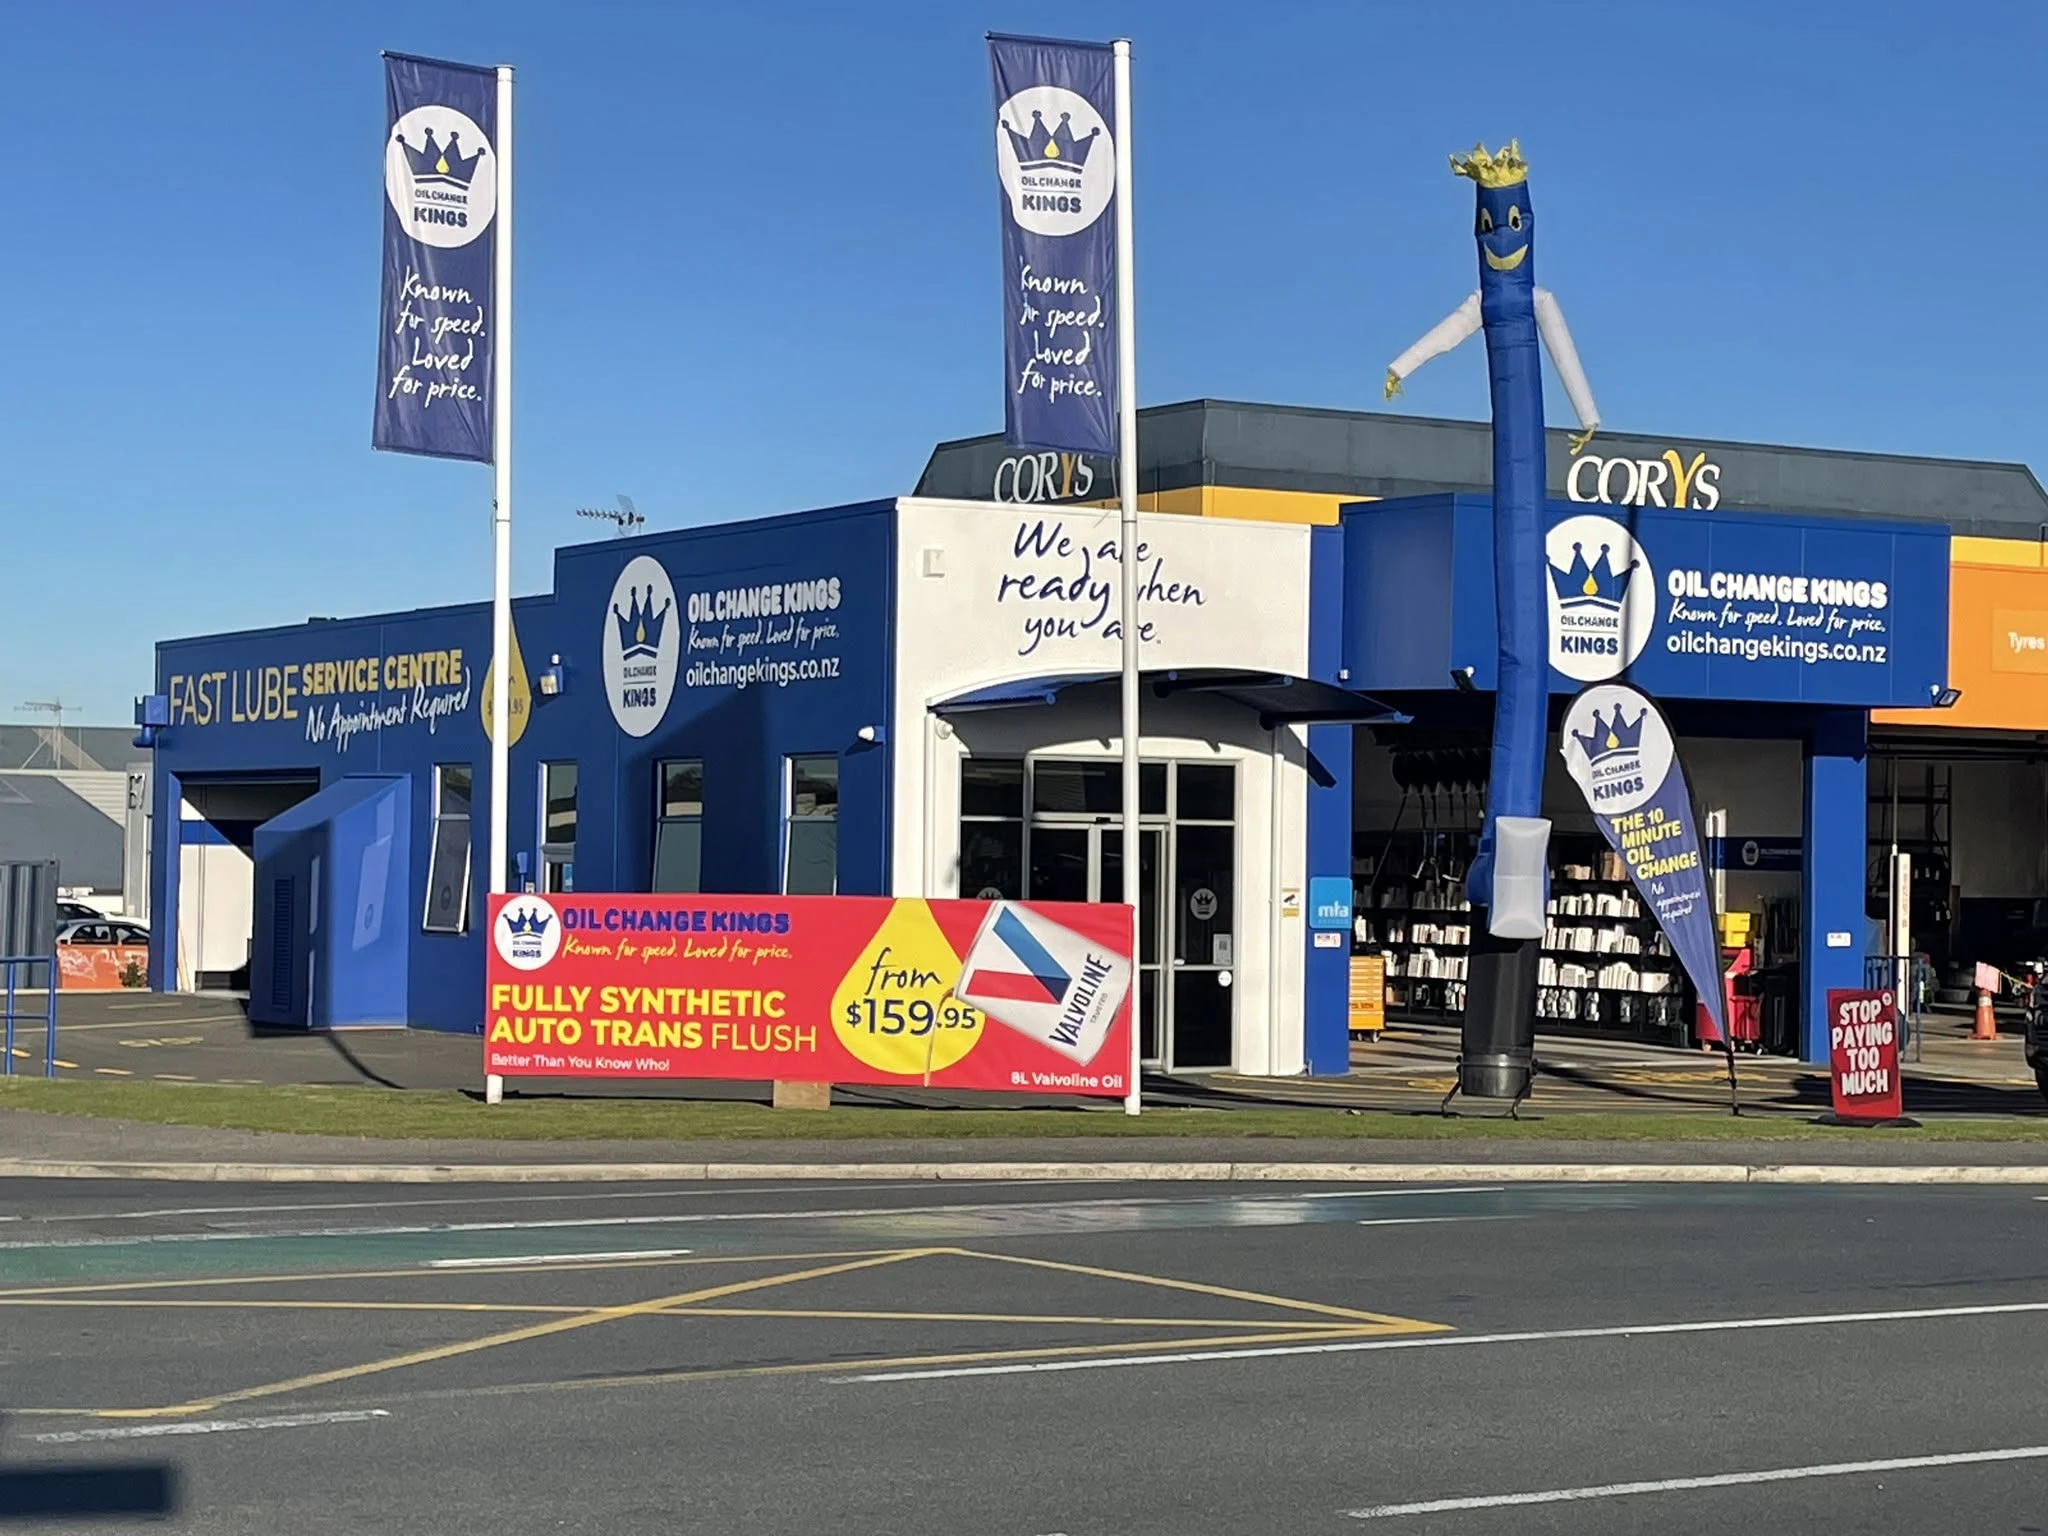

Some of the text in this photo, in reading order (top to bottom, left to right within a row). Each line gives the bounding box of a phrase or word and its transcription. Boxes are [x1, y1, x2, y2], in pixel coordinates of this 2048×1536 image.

[414, 207, 468, 228] KINGS
[1022, 194, 1082, 213] KINGS
[400, 265, 473, 304] Known
[430, 305, 486, 344] speed.
[1045, 295, 1104, 338] speed.
[412, 336, 474, 371] Loved
[1034, 330, 1091, 365] Loved
[388, 364, 482, 408] for price.
[1017, 358, 1102, 403] for price.
[1567, 449, 1721, 511] CORYS
[1014, 520, 1153, 564] We ae
[688, 577, 842, 623] OIL CHANGE KINGS
[997, 546, 1111, 628] ready
[1667, 569, 1888, 609] OIL CHANGE KINGS
[687, 623, 719, 655] Known
[719, 623, 736, 655] for
[766, 615, 795, 645] Loved
[1561, 615, 1619, 628] OIL CHANGE
[1668, 597, 1886, 638] Known for speed. Loved for price.
[1018, 616, 1162, 656] you ae.
[1561, 635, 1619, 655] KINGS
[1667, 629, 1887, 664] oilchangekings.co.nz
[2008, 632, 2046, 653] Tyres
[169, 648, 463, 726] FAST LUBE SERVICE CENTRE
[686, 656, 840, 690] oilchangekings.co.nz
[623, 687, 657, 708] KINGS
[305, 705, 326, 743] No
[327, 693, 408, 754] Appointment
[1593, 776, 1645, 801] KINGS
[1611, 807, 1664, 834] THE 10
[1622, 820, 1682, 849] MINUTE
[1626, 845, 1655, 865] OIL
[1636, 850, 1698, 880] CHANGE
[562, 908, 790, 934] OIL CHANGE KINGS
[562, 933, 793, 966] Known for speed. Loved for price.
[864, 946, 942, 996] from
[492, 984, 786, 1019] FULLY SYNTHETIC
[846, 998, 976, 1036] $159.95
[1048, 953, 1112, 1047] VALVOLINE
[1839, 999, 1882, 1026] STOP
[489, 1016, 817, 1053] AUTO TRANS FLUSH
[1832, 1021, 1893, 1050] PAYING
[491, 1053, 670, 1072] Better Than You Know Who!
[1846, 1047, 1880, 1072] TOO
[1011, 1071, 1122, 1089] 8L Valvoline Oil
[1841, 1069, 1889, 1096] MUCH
